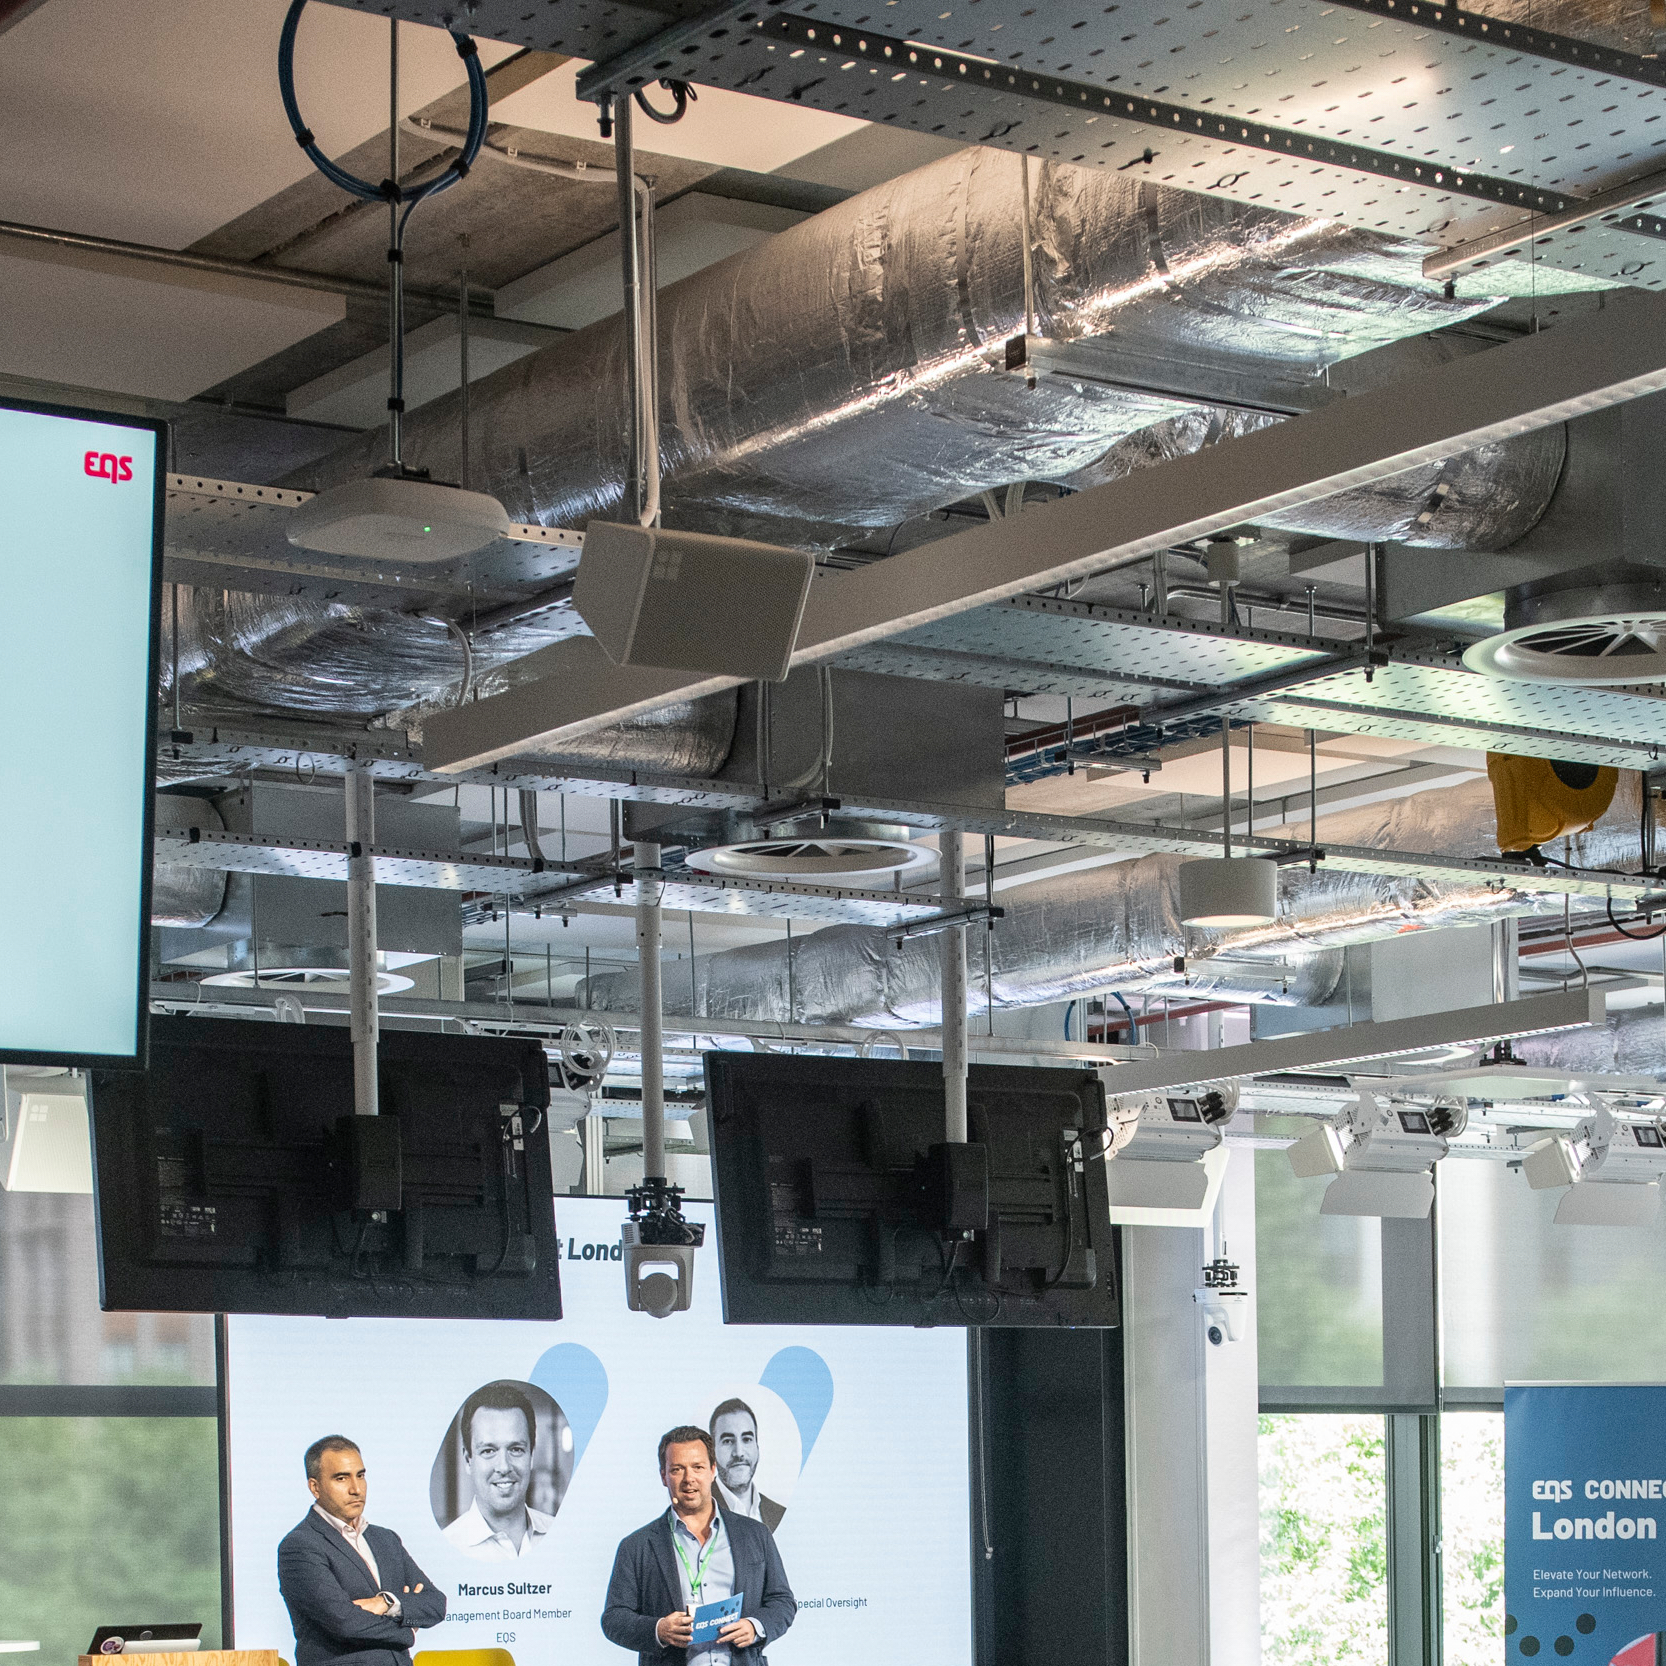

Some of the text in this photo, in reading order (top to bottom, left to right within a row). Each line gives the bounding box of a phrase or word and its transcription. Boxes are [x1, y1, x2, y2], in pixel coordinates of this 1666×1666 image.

[84, 451, 133, 484] EQS
[568, 1238, 623, 1261] Lond
[1532, 1480, 1573, 1503] EQS
[1532, 1511, 1657, 1540] London
[1533, 1568, 1653, 1580] Elevate Your Network.
[458, 1582, 552, 1596] Marcus Sultzer
[1533, 1586, 1656, 1600] Expand Your Influence.
[826, 1597, 868, 1609] Oversight
[445, 1608, 572, 1623] anagement Board Member
[709, 1611, 739, 1626] CONNECT
[496, 1632, 516, 1643] EQS
